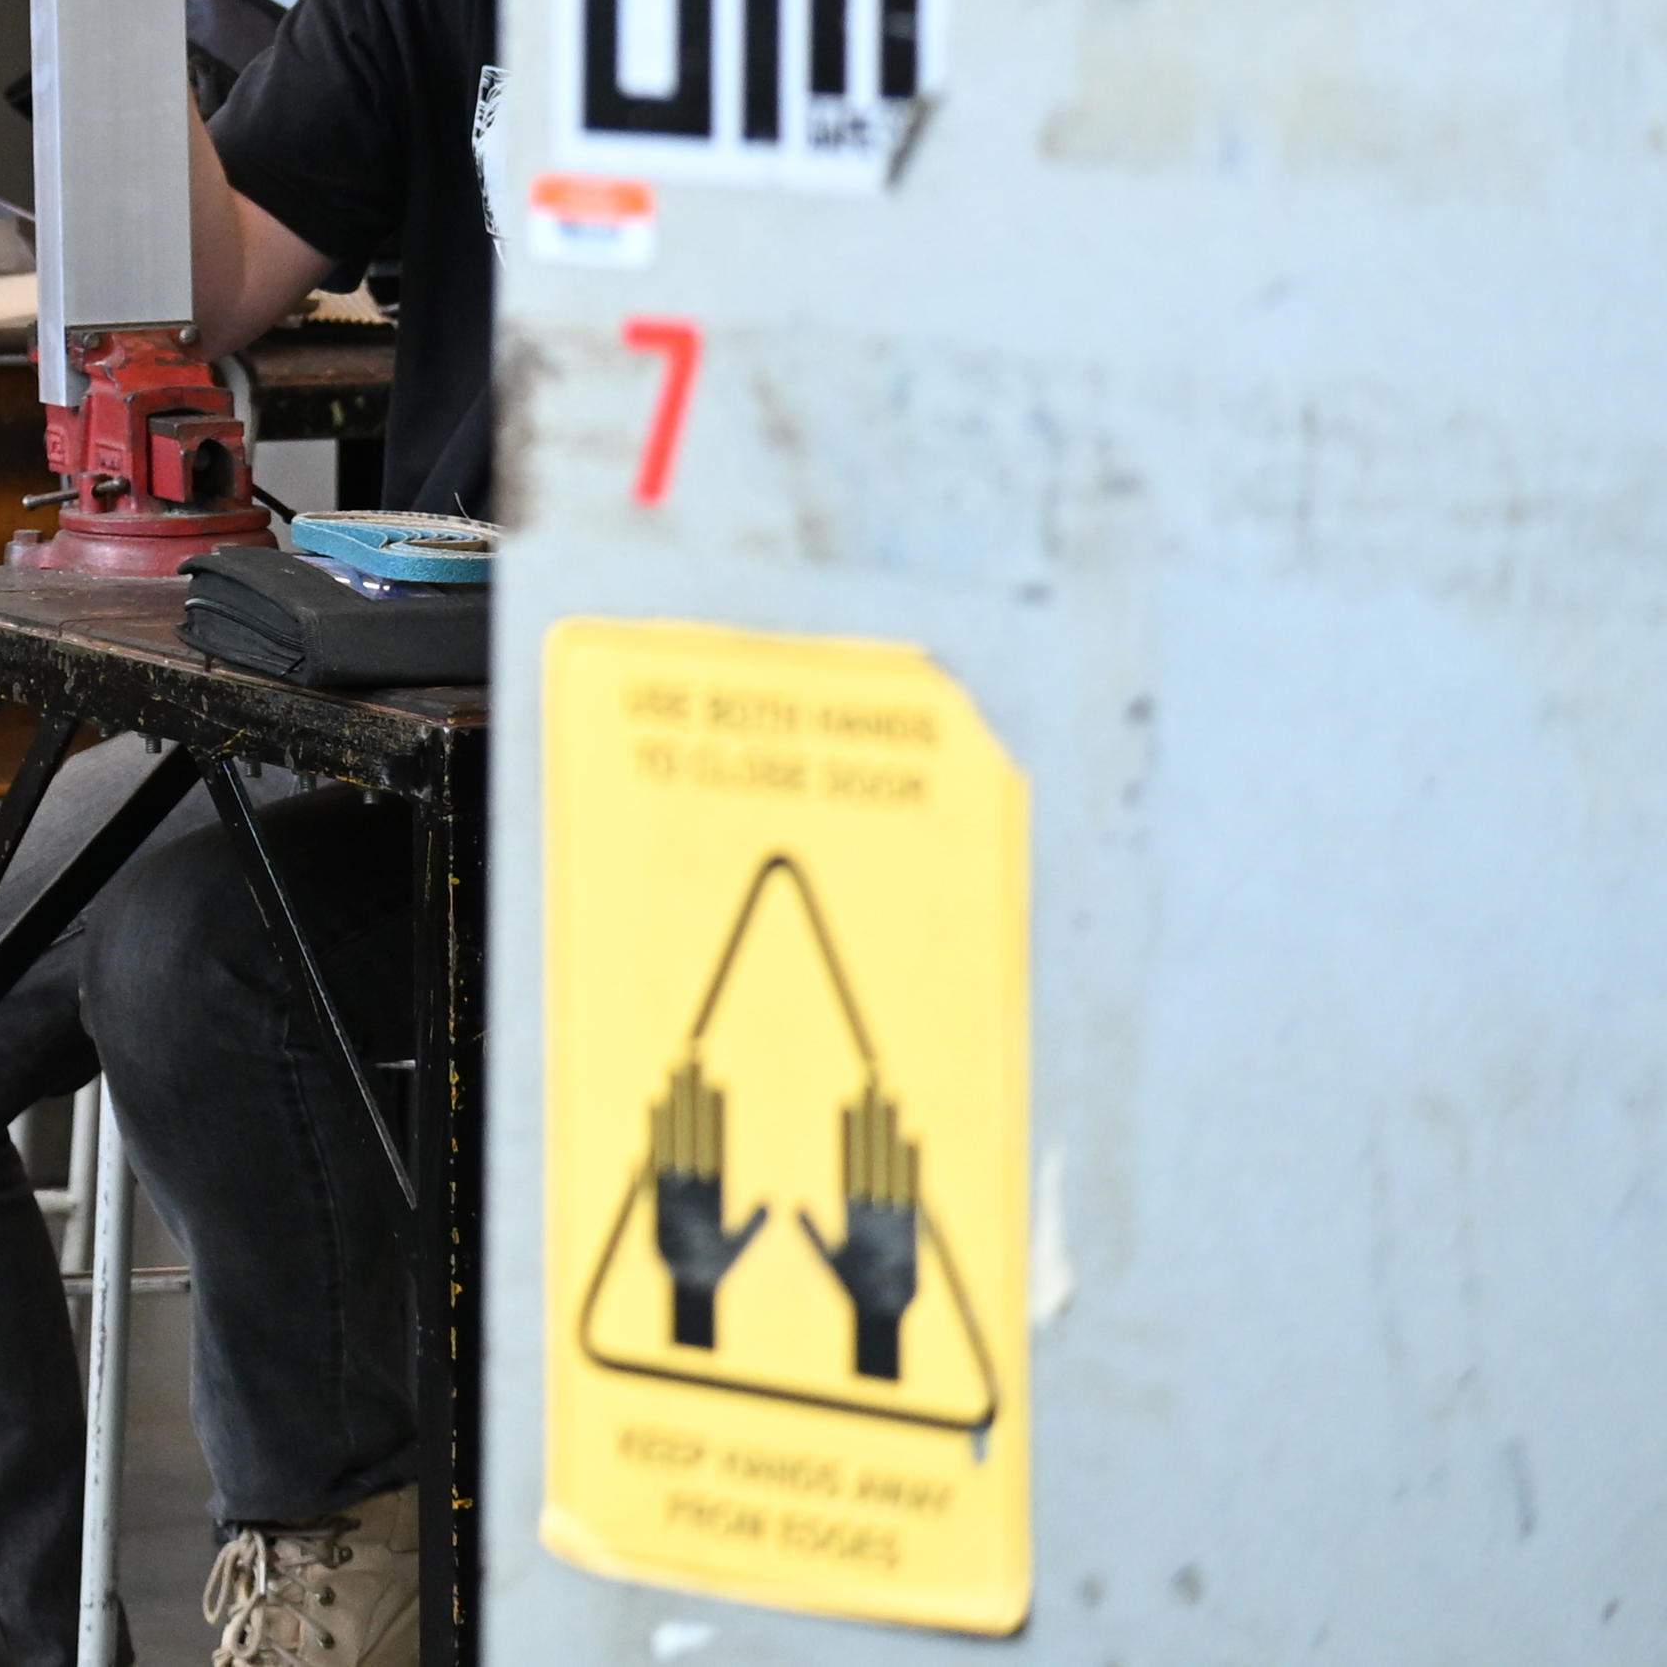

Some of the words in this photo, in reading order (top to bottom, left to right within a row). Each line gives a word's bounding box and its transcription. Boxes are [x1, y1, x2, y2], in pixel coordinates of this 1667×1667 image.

[624, 317, 703, 506] 7
[708, 691, 800, 733] BOTH
[819, 703, 937, 746] HANDS
[618, 1427, 706, 1470] KEEP
[721, 1448, 842, 1502] HANDS
[666, 1493, 766, 1542] FROM
